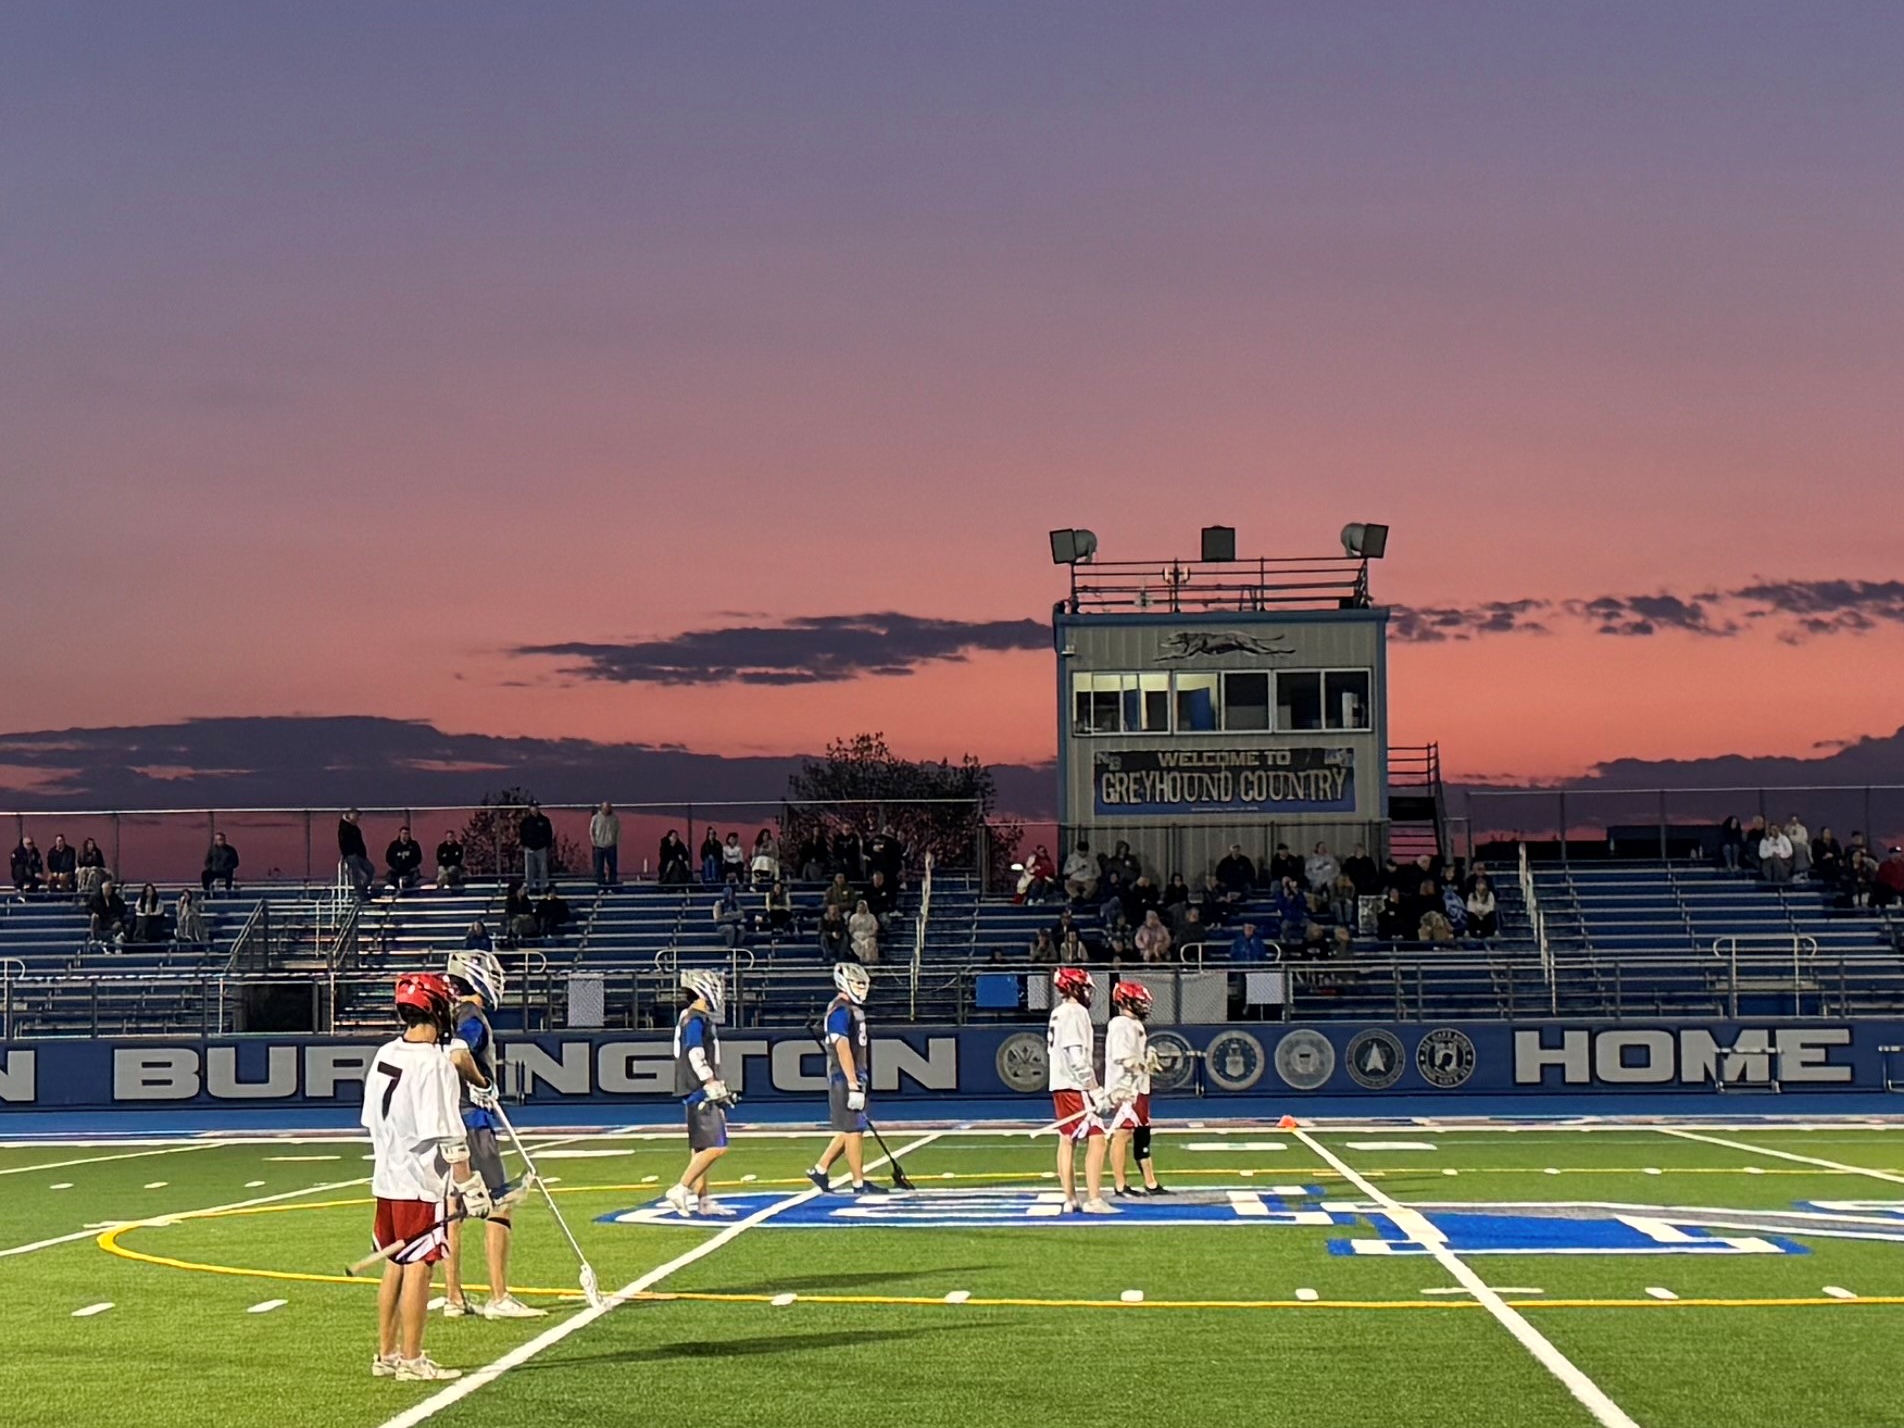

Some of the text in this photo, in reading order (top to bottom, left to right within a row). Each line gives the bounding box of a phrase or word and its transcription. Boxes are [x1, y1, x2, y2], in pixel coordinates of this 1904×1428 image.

[1101, 768, 1347, 804] GREYHOUND COUNTRY
[1157, 750, 1291, 767] WELCOME TO
[113, 1037, 957, 1100] BURNGTON
[1514, 1028, 1852, 1084] HOME
[376, 1060, 403, 1121] 7
